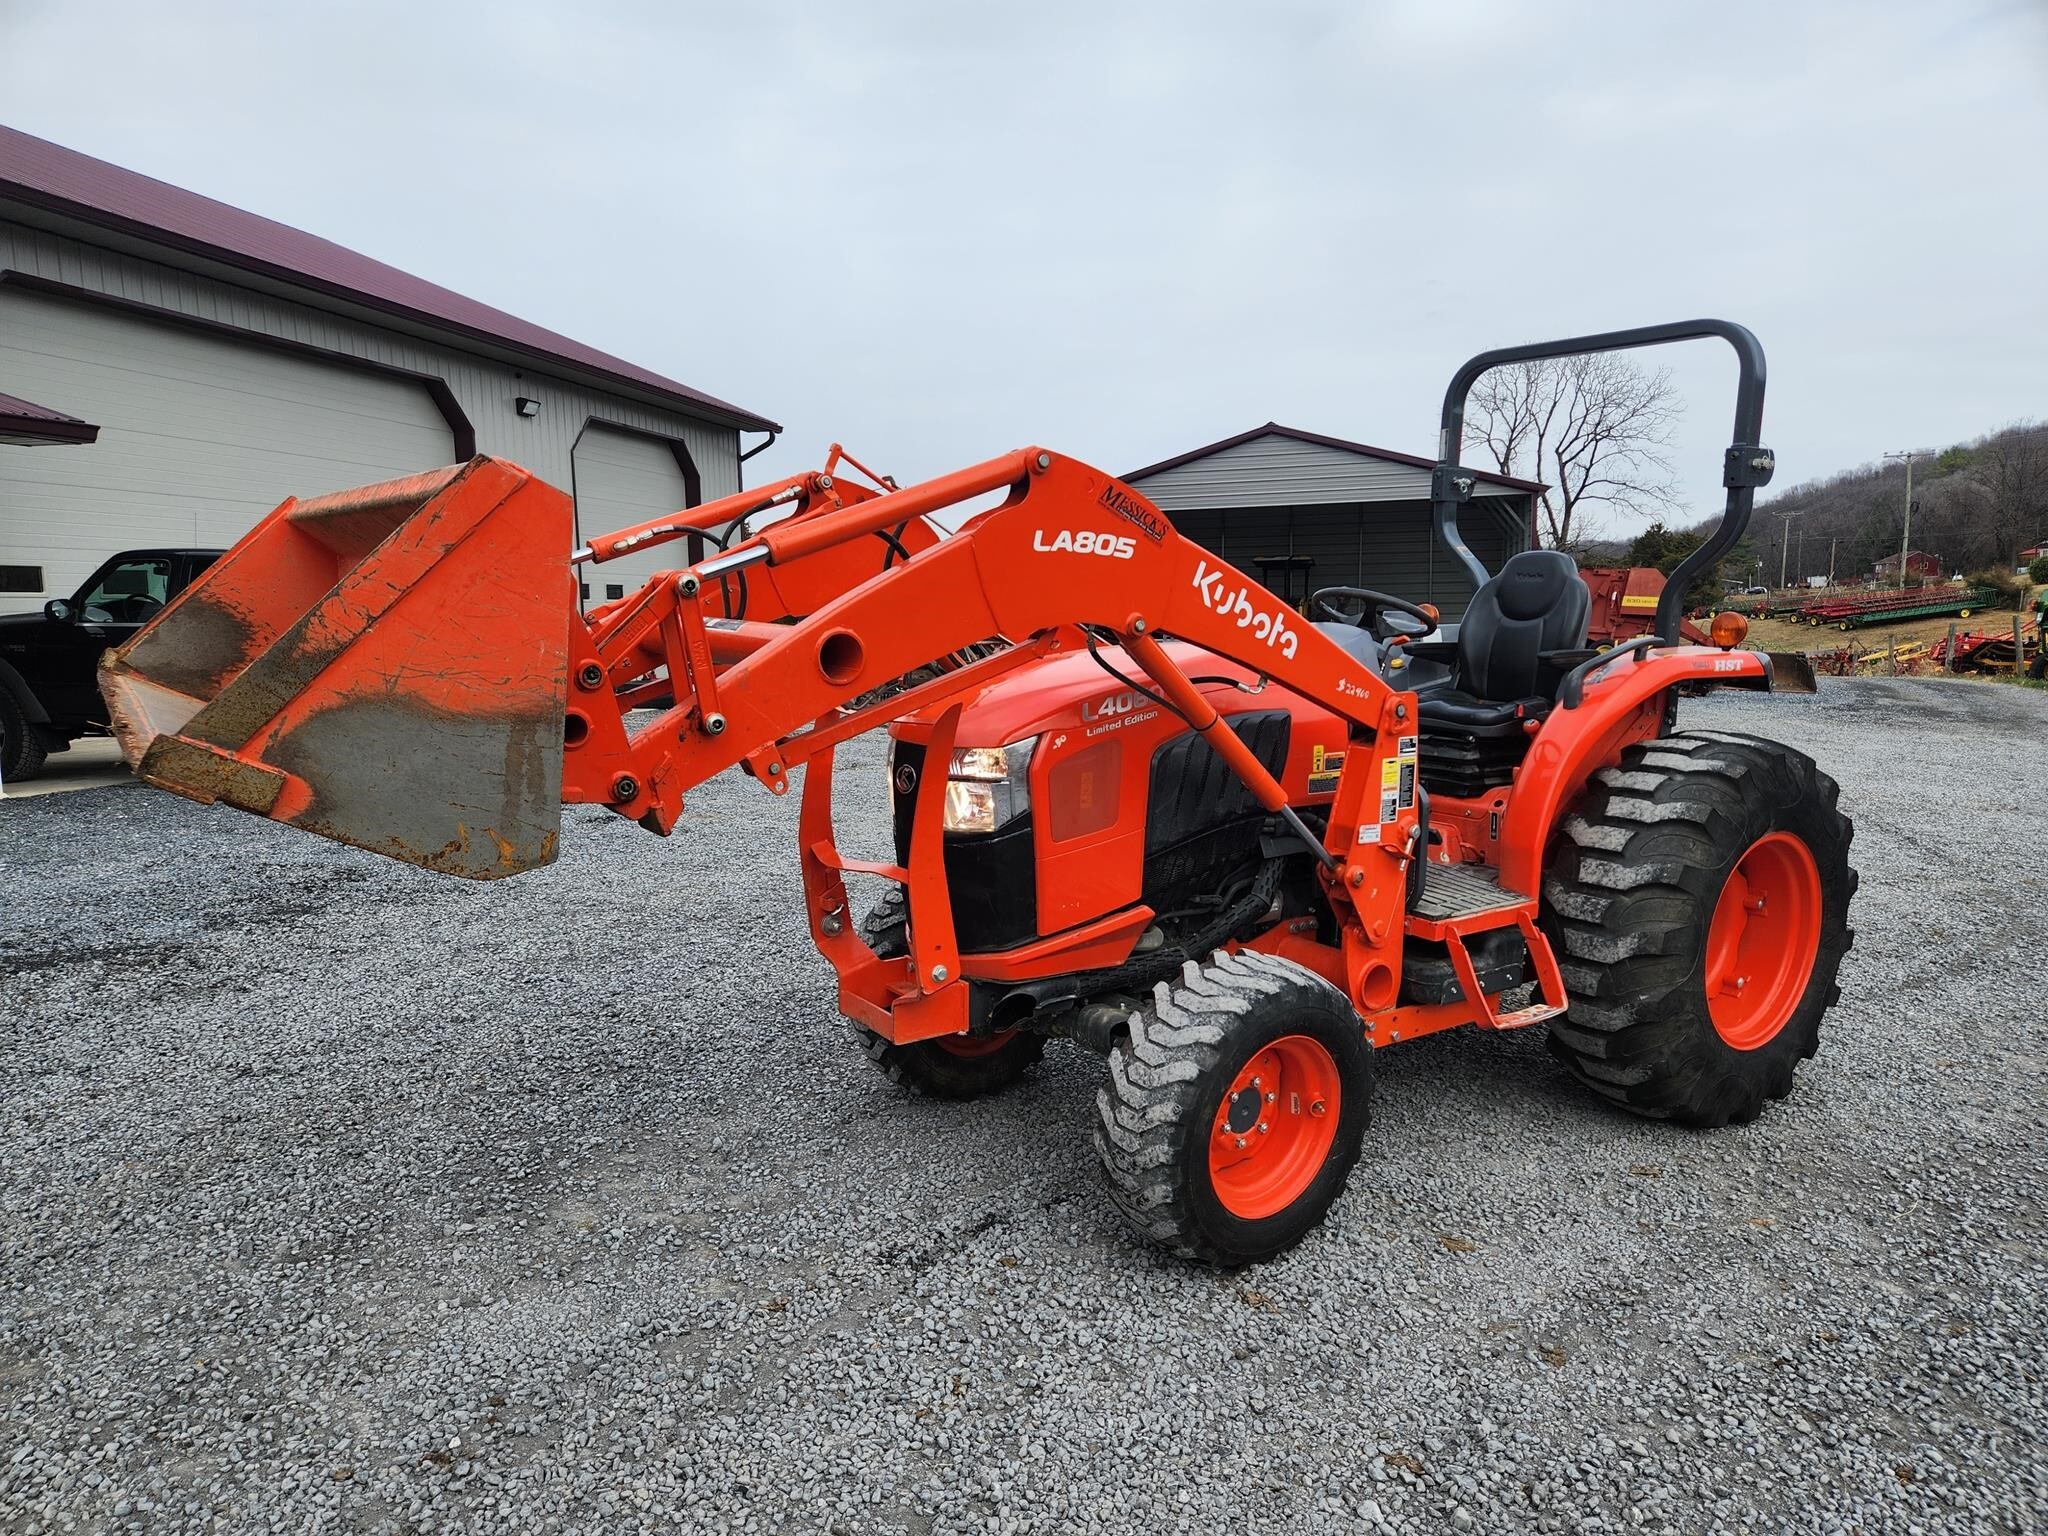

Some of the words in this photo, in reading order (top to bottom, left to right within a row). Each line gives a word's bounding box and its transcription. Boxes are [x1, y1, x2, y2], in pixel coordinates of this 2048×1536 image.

[1033, 529, 1137, 559] LA805
[1192, 560, 1299, 660] Kubota
[1713, 659, 1744, 672] HST
[1086, 719, 1122, 737] Limited
[1124, 710, 1158, 726] Edition
